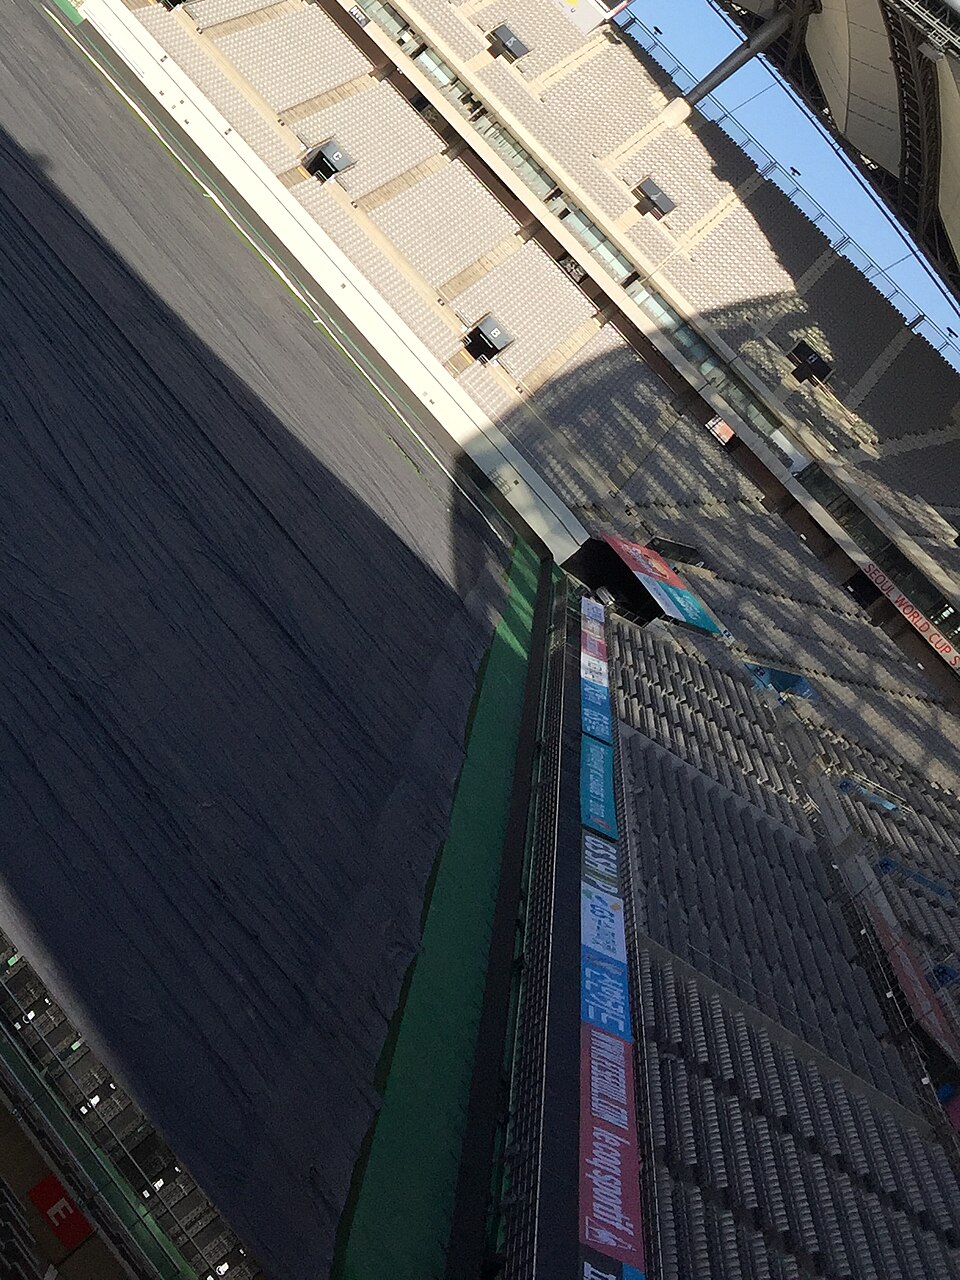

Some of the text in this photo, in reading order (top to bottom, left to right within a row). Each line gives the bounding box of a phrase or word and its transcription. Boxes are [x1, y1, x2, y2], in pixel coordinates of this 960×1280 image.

[505, 36, 517, 48] K
[333, 151, 343, 160] C
[490, 328, 500, 338] B
[864, 563, 895, 598] SEOUL
[894, 594, 930, 632] WORLD
[928, 632, 952, 654] CUP
[585, 968, 625, 1032] 신한카드
[591, 1030, 629, 1131] WWW.FCSEOUL.COM
[47, 1198, 74, 1226] E
